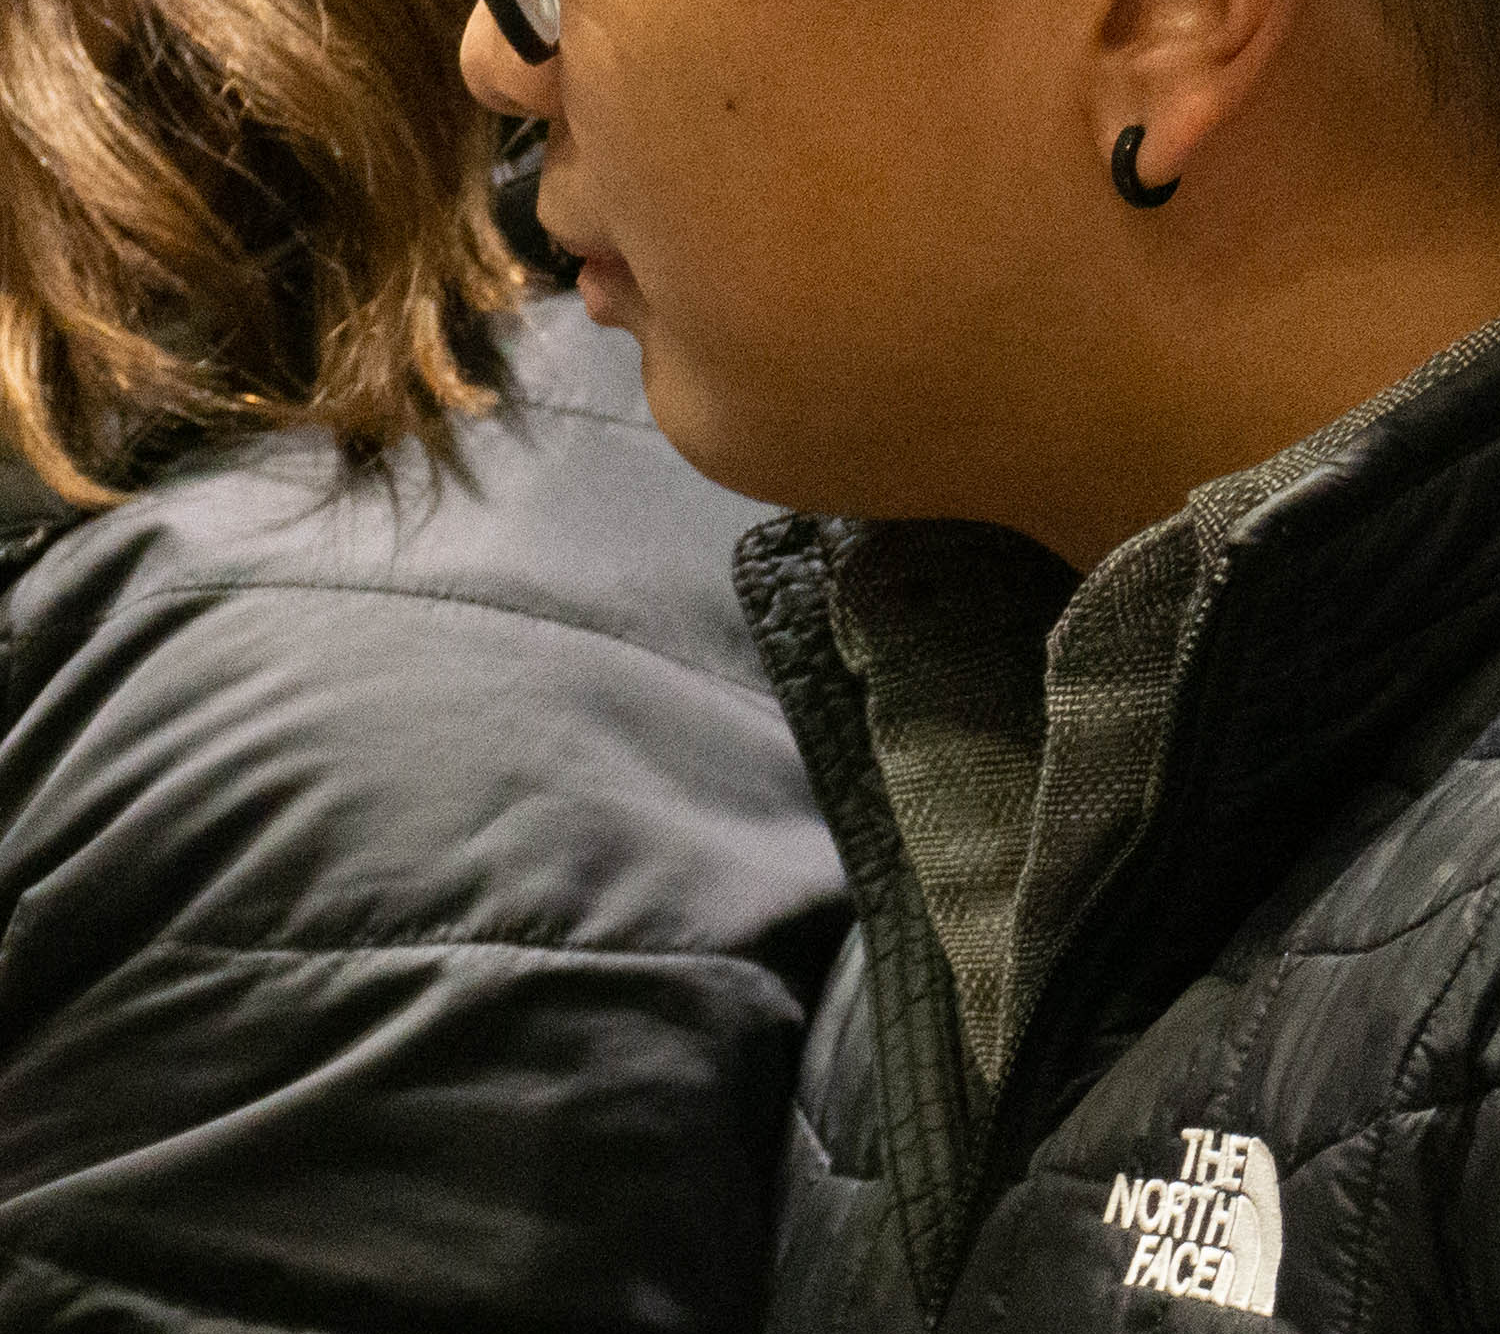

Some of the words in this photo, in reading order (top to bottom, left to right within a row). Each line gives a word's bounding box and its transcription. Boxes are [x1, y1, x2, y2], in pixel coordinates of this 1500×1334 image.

[1181, 1127, 1250, 1192] THE
[1103, 1172, 1238, 1248] NORTH
[1123, 1234, 1224, 1301] FACE
